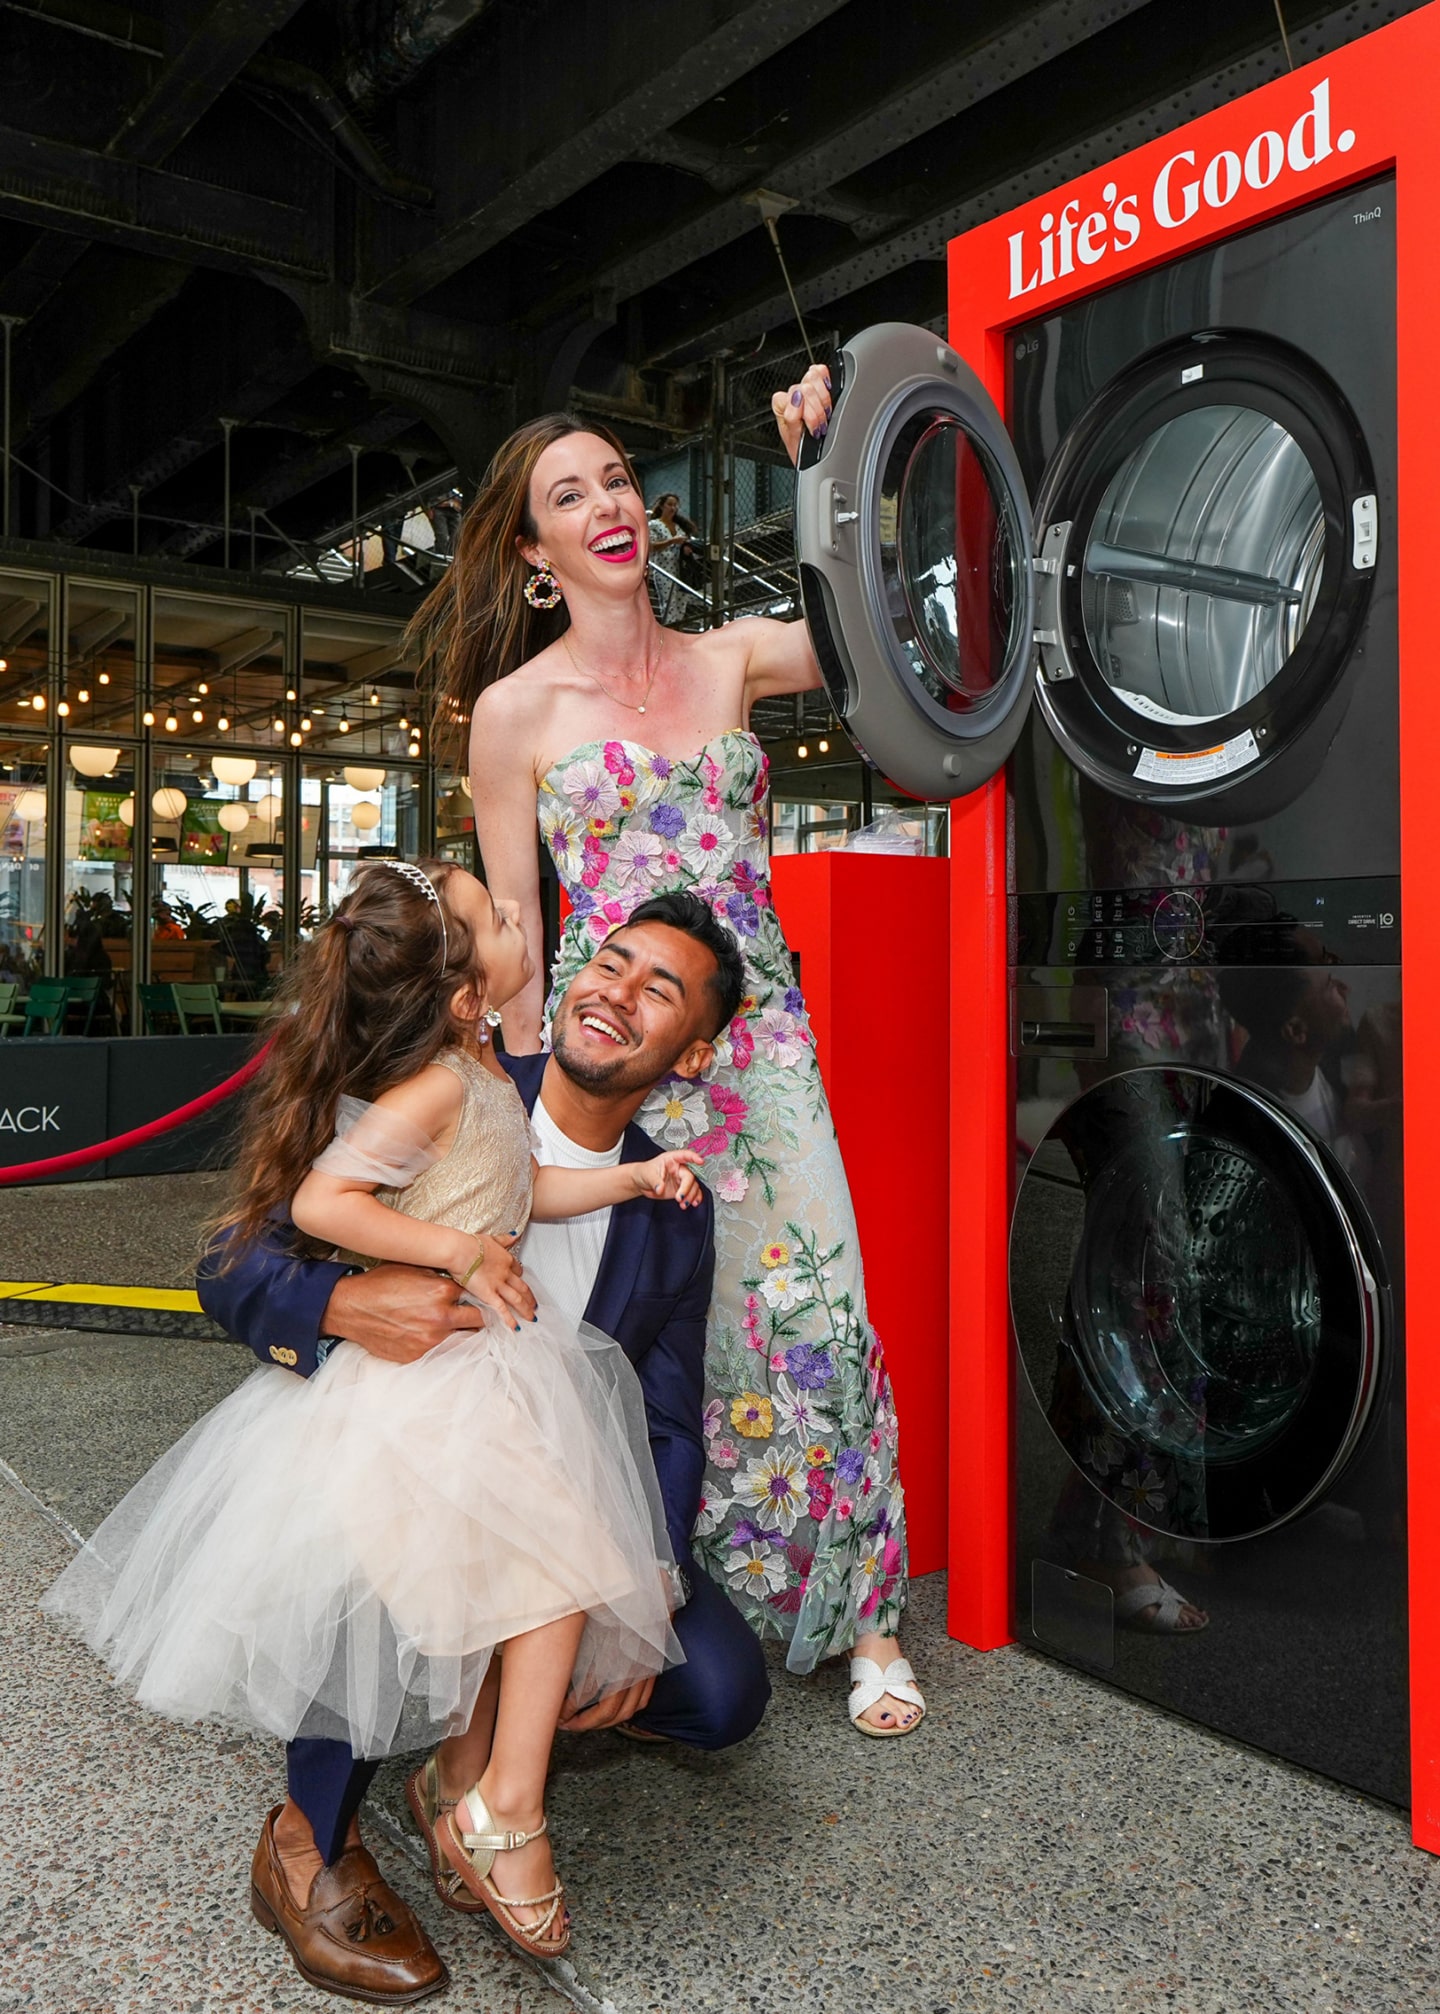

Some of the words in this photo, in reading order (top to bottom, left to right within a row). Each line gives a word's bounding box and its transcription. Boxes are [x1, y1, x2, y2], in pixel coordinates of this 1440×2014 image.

[1007, 182, 1141, 300] Life's
[1152, 77, 1356, 229] Good.
[1352, 206, 1382, 225] ThinQ
[1027, 339, 1039, 354] LG
[0, 1105, 60, 1133] ACK
